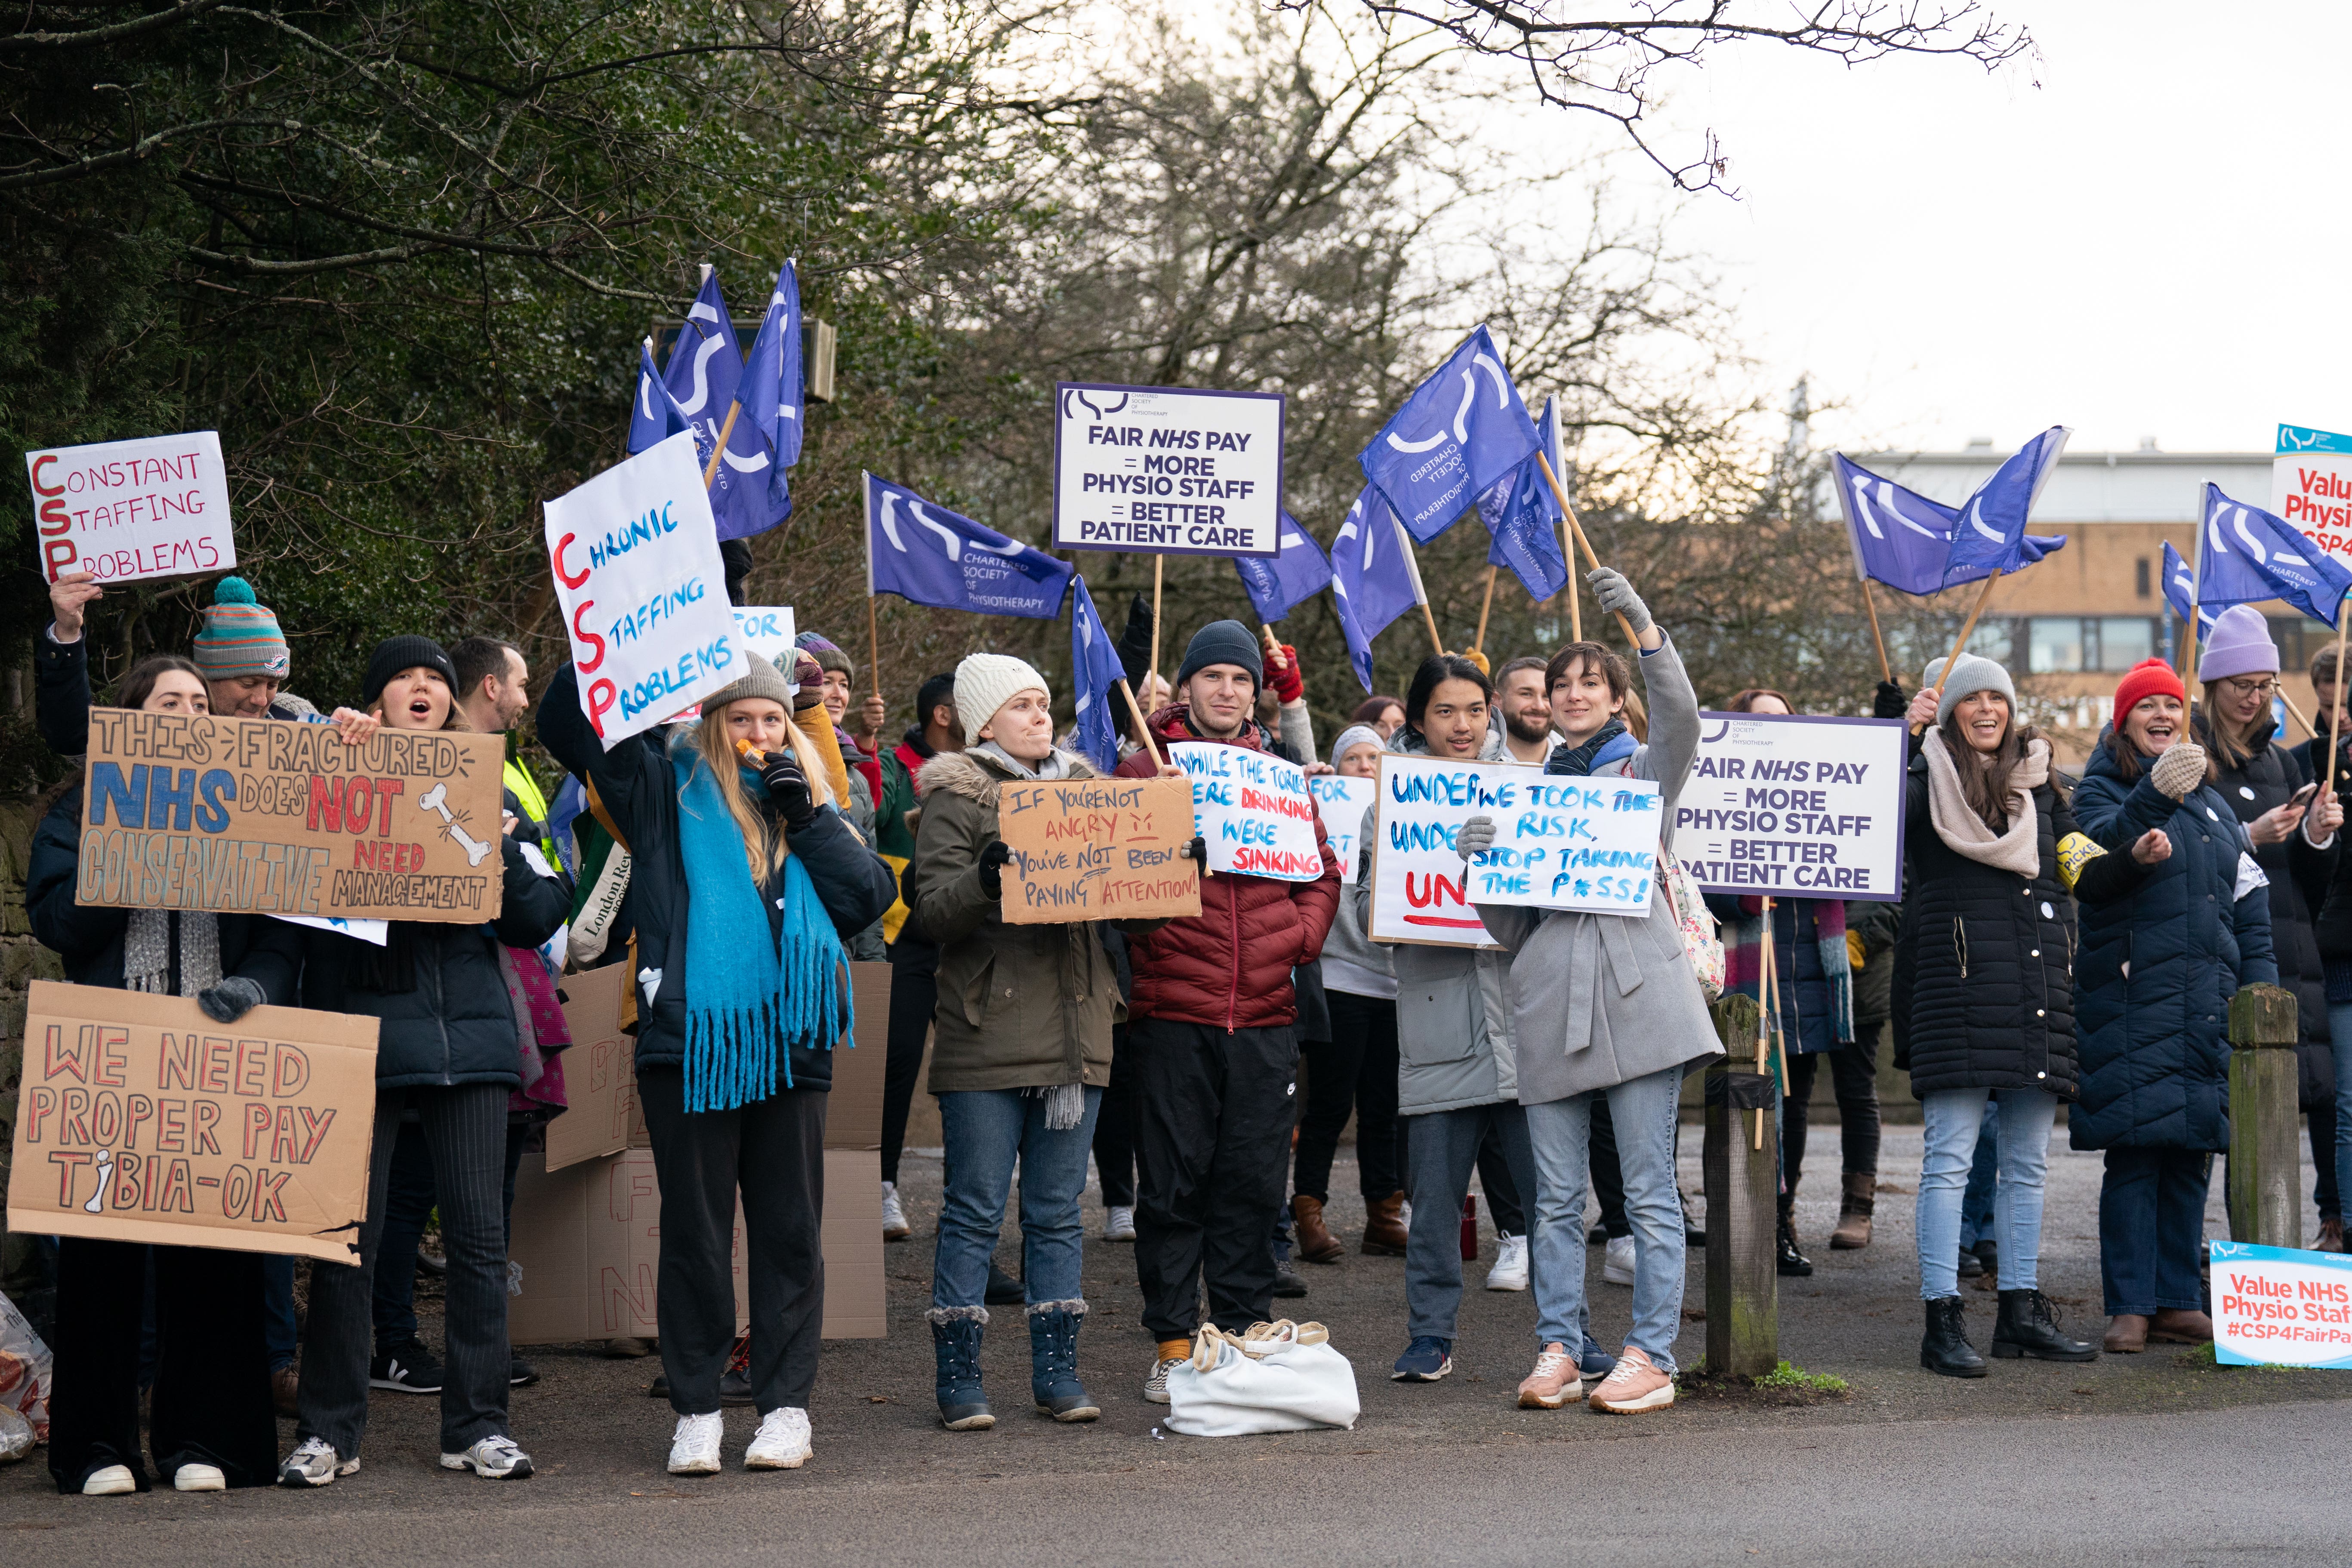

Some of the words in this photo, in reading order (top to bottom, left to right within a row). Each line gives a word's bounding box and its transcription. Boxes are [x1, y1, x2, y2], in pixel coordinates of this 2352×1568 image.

[1088, 425, 1143, 447] FAIR
[1148, 429, 1201, 450] NHS
[1206, 431, 1251, 452] PAY
[32, 453, 200, 497] CONSTANT
[1144, 455, 1215, 477] MORE
[1083, 473, 1172, 496] PHYSIO
[1179, 478, 1255, 499] STAFF
[2298, 468, 2352, 500] Valu
[40, 490, 205, 536] STAFFING
[1131, 502, 1225, 524] BETTER
[2285, 494, 2352, 529] Physi
[554, 500, 678, 590] CHRONIC
[1081, 521, 1182, 543] PATIENT
[1188, 526, 1254, 548] CARE
[44, 537, 219, 584] PROBLEMS
[964, 553, 1029, 572] CHARTERED
[964, 567, 1009, 580] SOCIETY
[965, 580, 976, 590] OF
[2267, 565, 2317, 586] CHARTERED
[968, 592, 1044, 609] PHYSIOTHERAPY
[573, 576, 704, 674] STAFFING
[587, 635, 733, 738] PROBLEMS
[91, 710, 215, 765] THIS
[239, 722, 457, 778] FRACTURED
[1173, 750, 1231, 777] WHILE
[1236, 755, 1266, 784] THE
[1270, 765, 1308, 795] TORIES
[1751, 760, 1811, 782] NHS
[1816, 762, 1869, 784] PAY
[89, 761, 237, 834] NHS
[240, 773, 308, 816] DOES
[306, 775, 404, 838] NOT
[1010, 788, 1045, 815] IF
[1193, 781, 1234, 806] ERE
[1242, 787, 1313, 822] DRINKING
[1392, 773, 1480, 806] UNDER
[1479, 782, 1517, 809] WE
[1526, 786, 1604, 810] TOOK
[1611, 790, 1658, 812] THE
[1745, 788, 1826, 811] MORE
[1045, 813, 1118, 842] ANGRY
[1223, 818, 1278, 846] WERE
[1677, 808, 1778, 832] PHYSIO
[1784, 813, 1871, 836] STAFF
[1391, 820, 1461, 853] UNDE
[1076, 842, 1117, 870] NOT
[1128, 847, 1173, 869] BEEN
[1232, 847, 1320, 874] SINKING
[1473, 847, 1546, 869] STOP
[1557, 847, 1654, 871] TAKING
[1730, 839, 1837, 864] BETTER
[2064, 843, 2097, 871] PICKE
[81, 829, 330, 913] CONSERVATIVE
[354, 839, 425, 874] NEED
[1479, 872, 1532, 896] THE
[1794, 865, 1870, 889] CARE
[331, 869, 487, 910] MANAGEMENT
[583, 881, 622, 938] London
[612, 851, 632, 880] Rev
[1025, 879, 1088, 908] PAYING
[1103, 869, 1197, 905] ATTENTION!
[1406, 871, 1466, 908] UN
[44, 1024, 129, 1087] WE
[159, 1033, 310, 1098] NEED
[27, 1086, 222, 1155] PROPER
[243, 1103, 336, 1164] PAY
[2230, 1273, 2292, 1298] Value
[2298, 1280, 2349, 1303] NHS
[2223, 1295, 2298, 1321] Physio
[2303, 1303, 2352, 1323] Staf
[2227, 1322, 2352, 1346] #CSP4FairPa
